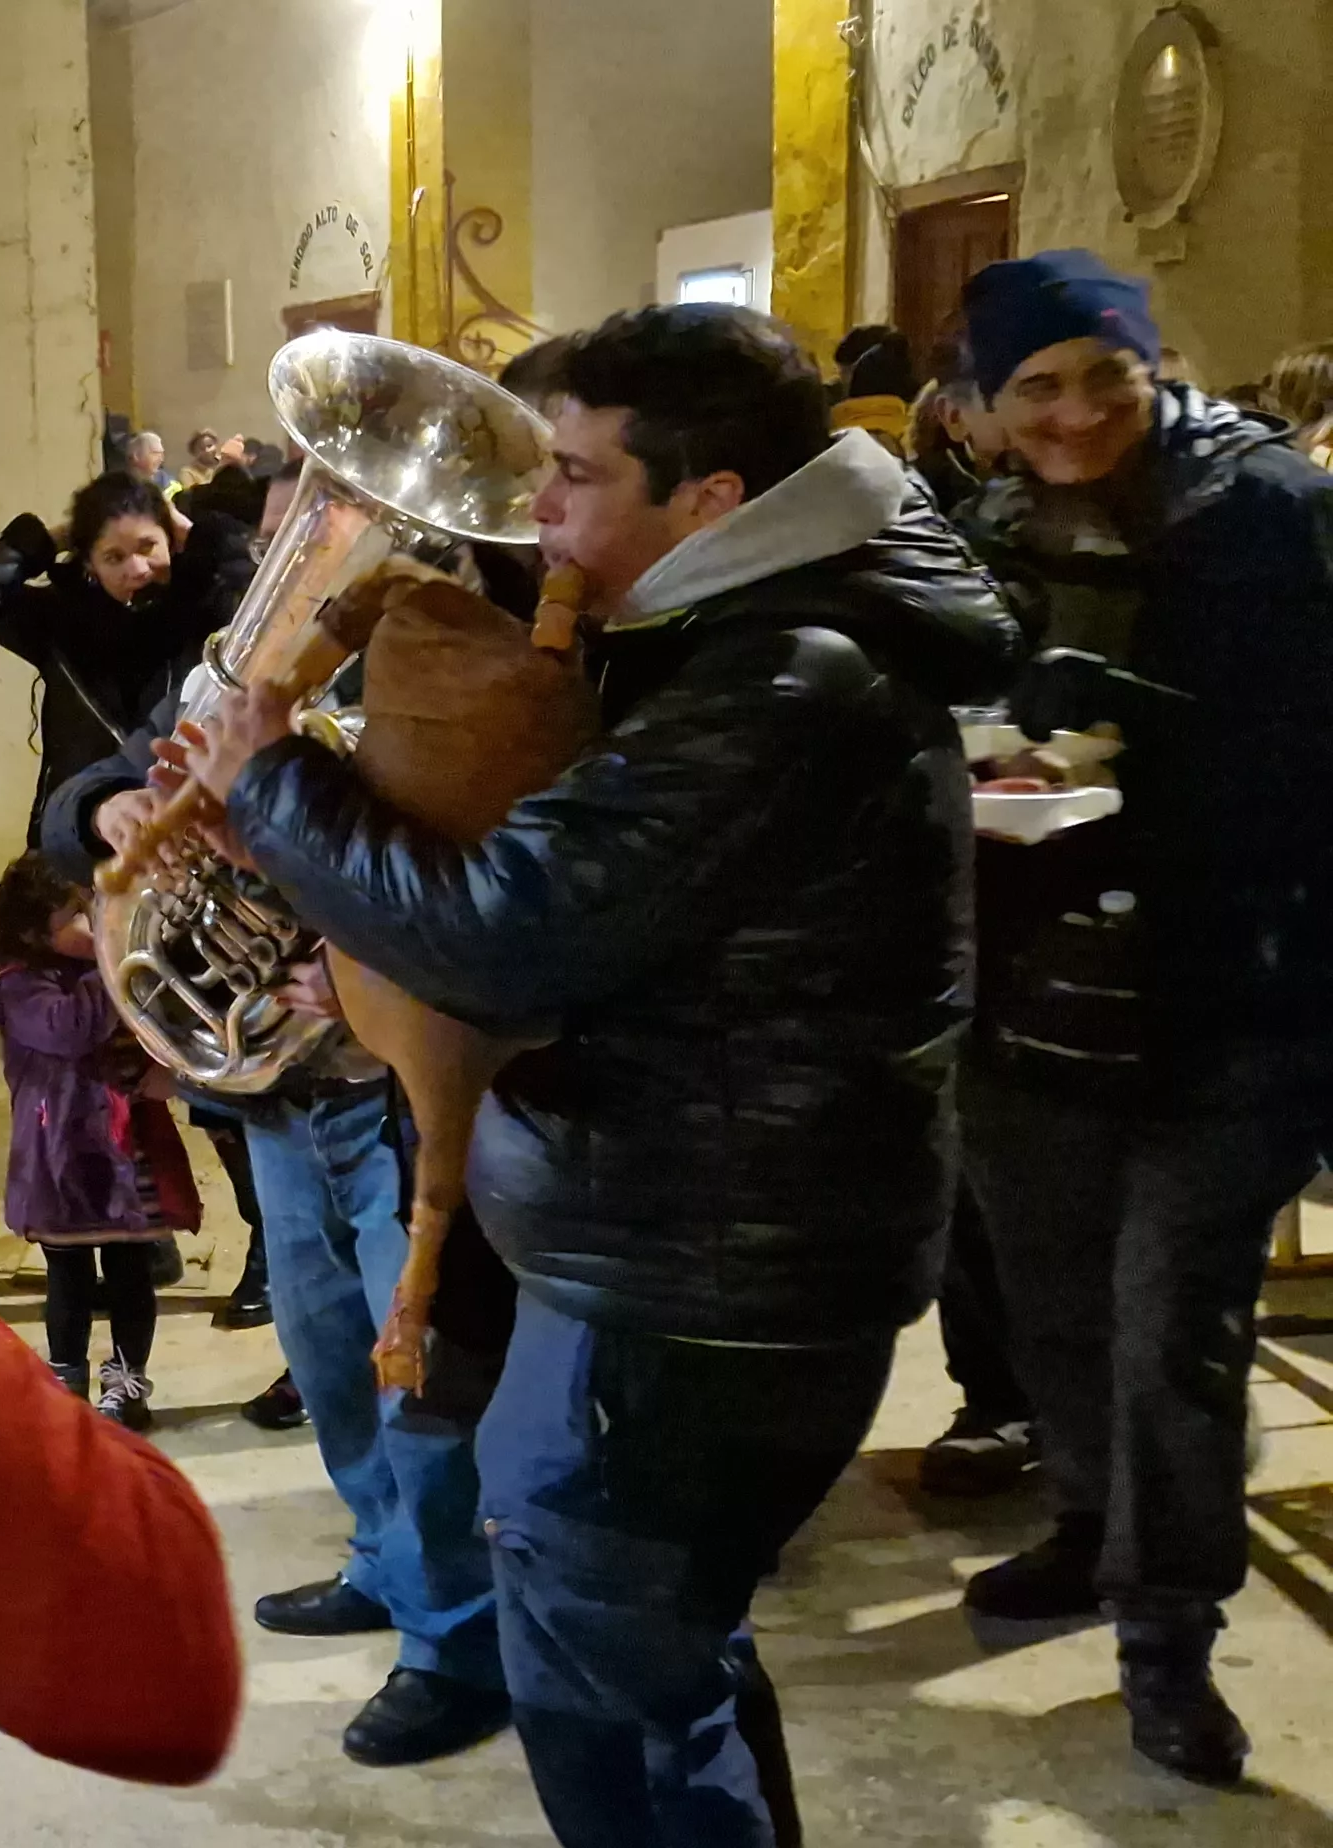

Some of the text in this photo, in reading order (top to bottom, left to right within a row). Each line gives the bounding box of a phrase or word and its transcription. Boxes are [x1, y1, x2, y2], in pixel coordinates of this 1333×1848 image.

[902, 43, 937, 129] PALCO
[289, 205, 374, 290] TENDIDO ALTO DE SOL
